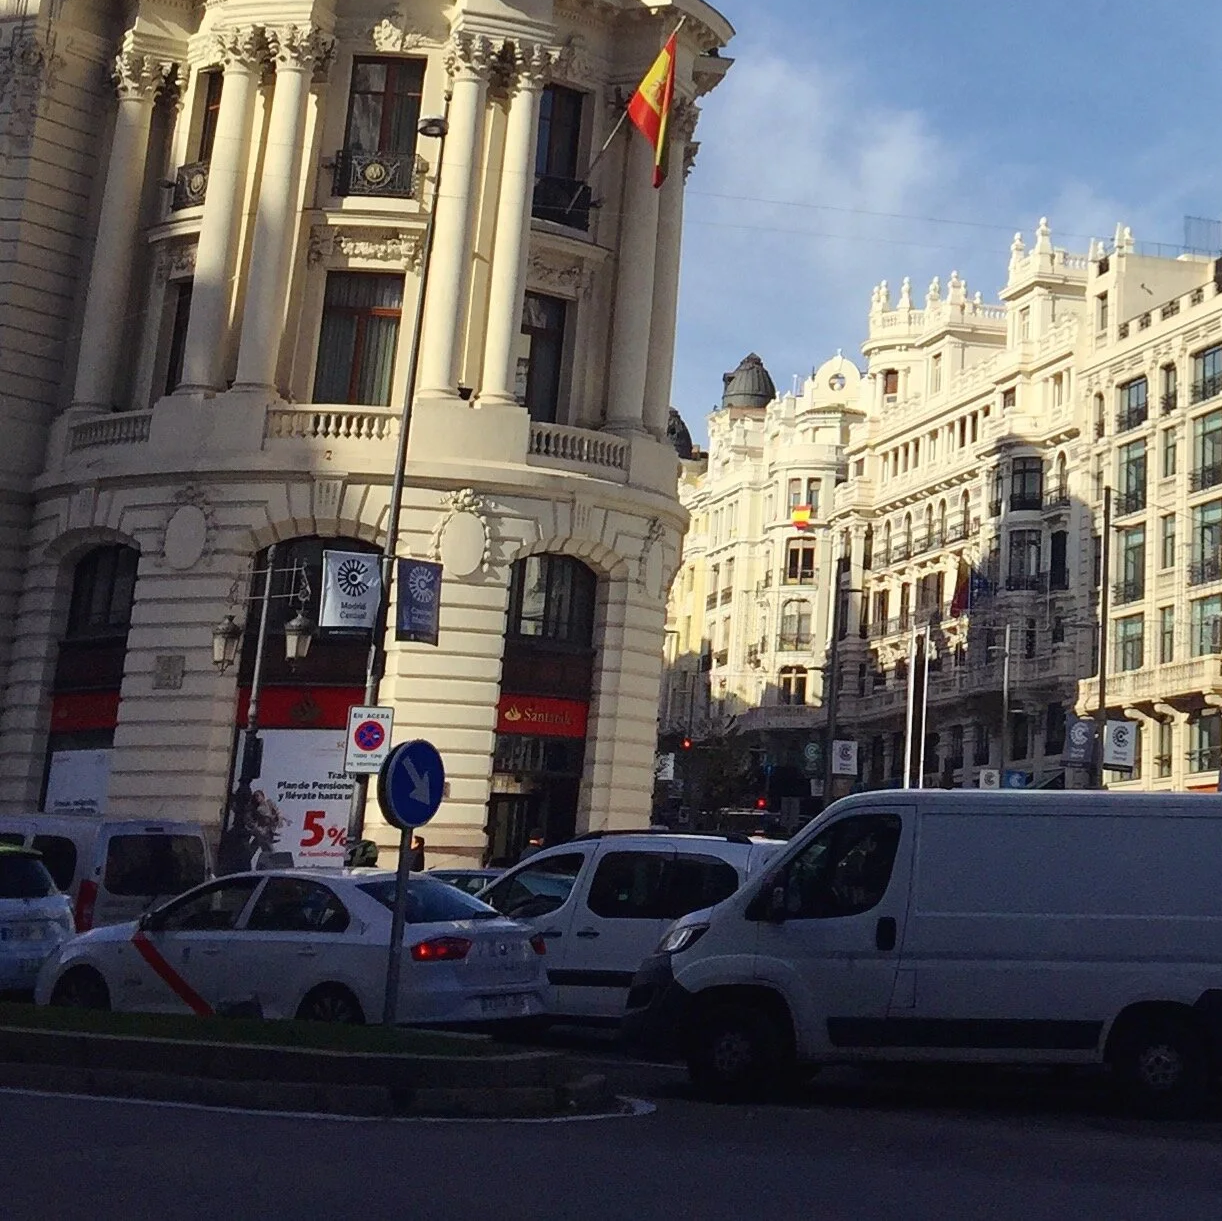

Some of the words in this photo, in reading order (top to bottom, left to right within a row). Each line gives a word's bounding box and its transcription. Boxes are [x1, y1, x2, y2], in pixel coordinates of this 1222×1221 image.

[340, 601, 367, 610] Madrid
[328, 771, 347, 780] Trae
[277, 781, 297, 790] Plan
[297, 781, 310, 790] de
[312, 781, 354, 790] Pensione
[318, 791, 343, 800] hasta
